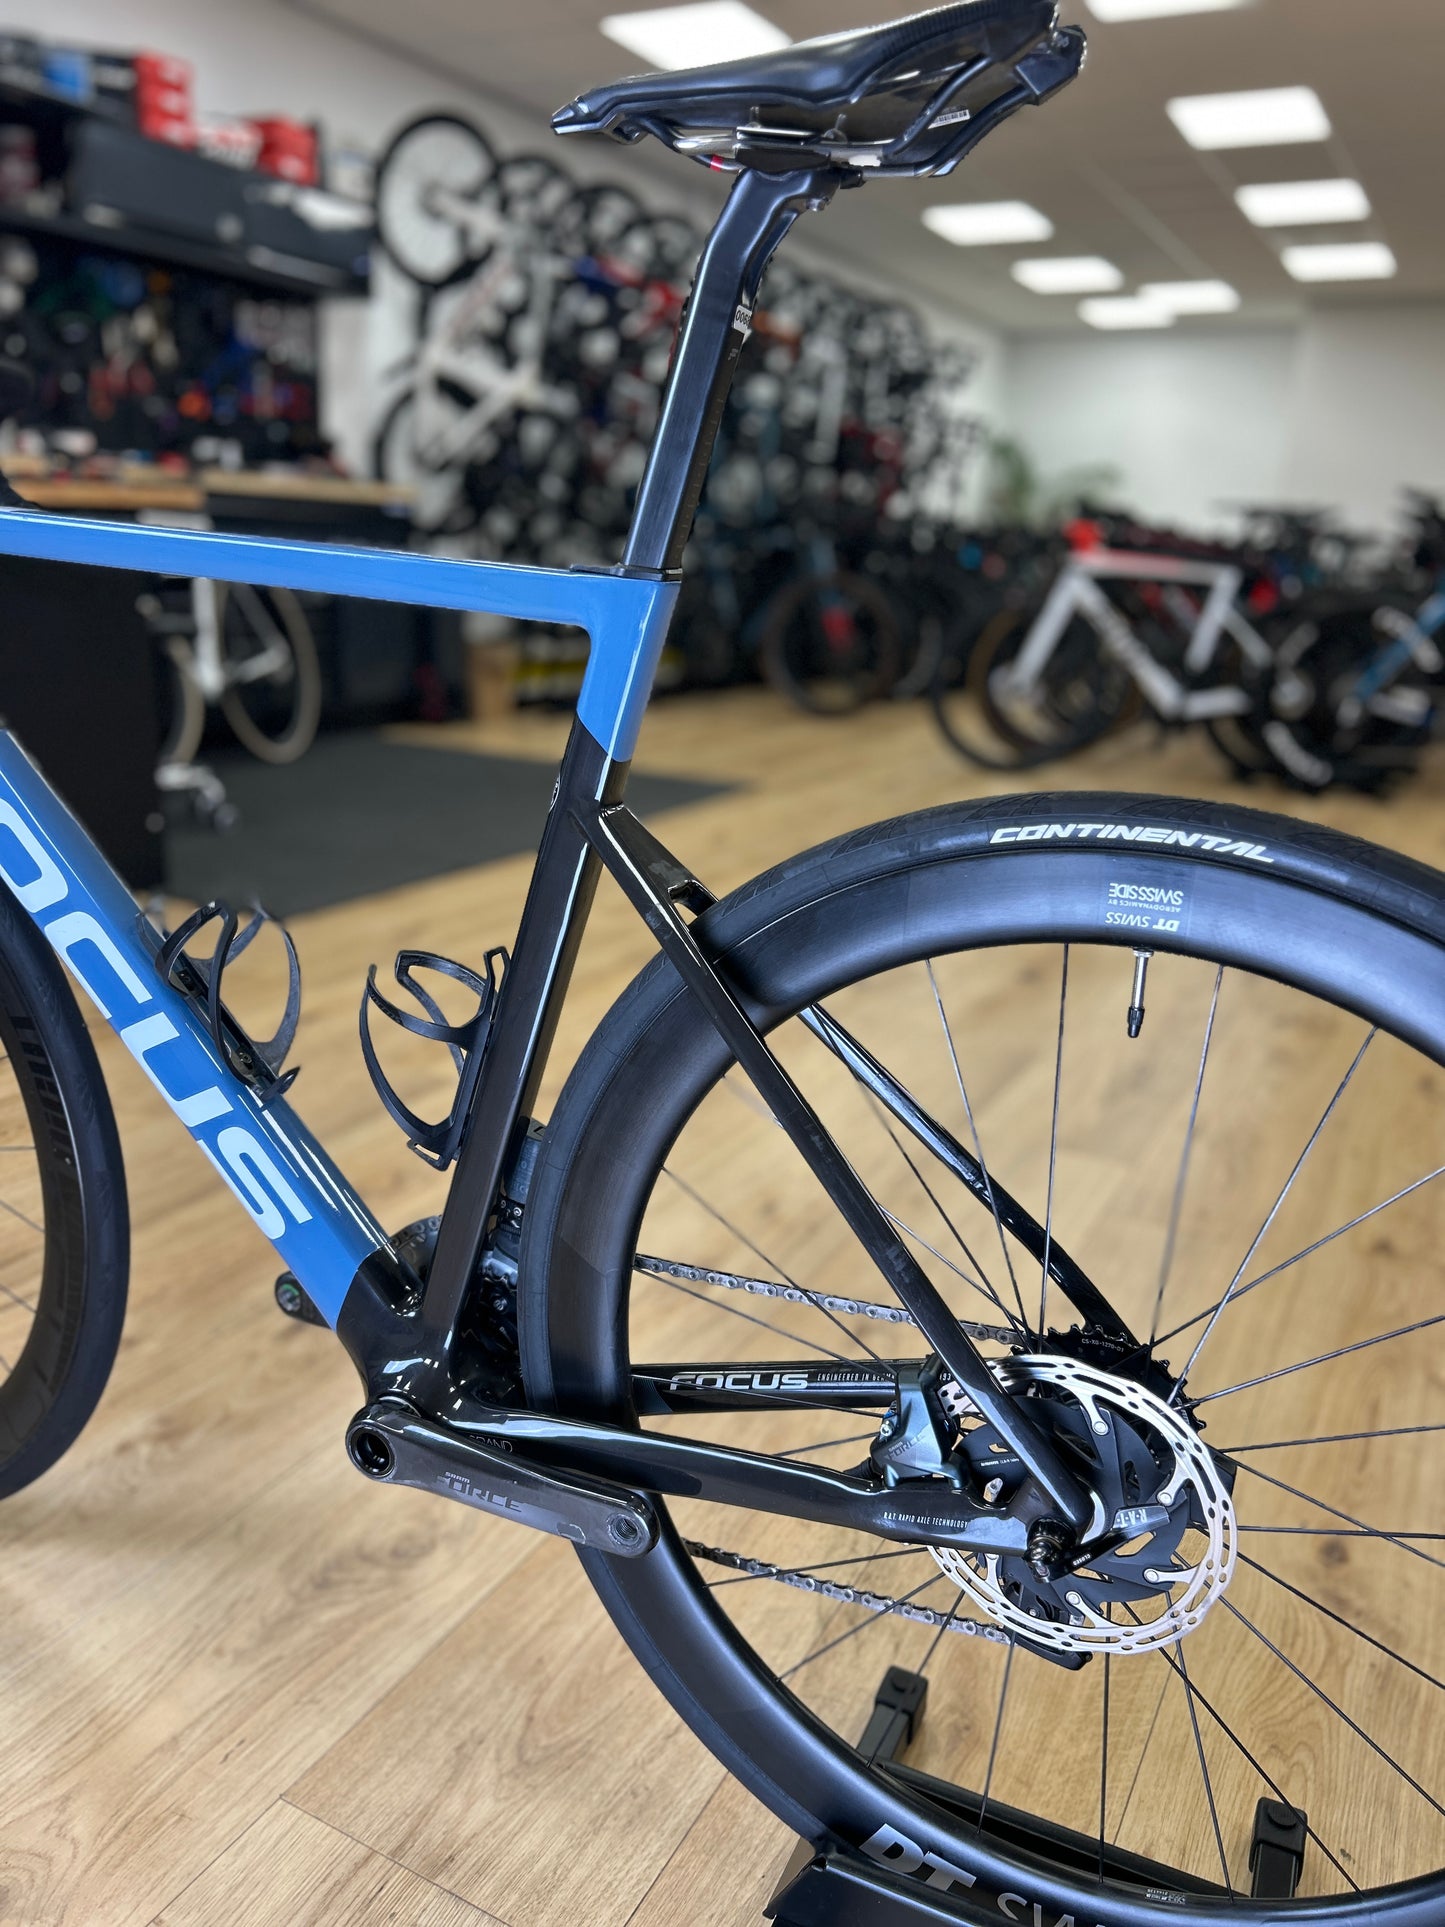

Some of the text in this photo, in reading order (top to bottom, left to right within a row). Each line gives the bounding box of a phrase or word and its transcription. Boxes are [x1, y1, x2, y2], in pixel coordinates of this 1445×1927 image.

[989, 823, 1274, 863] CONTINENTAL
[1119, 901, 1181, 912] AERODYNAMICS
[1105, 912, 1180, 932] DT SWISS
[670, 1373, 808, 1390] FOCUS
[817, 1373, 859, 1381] ENGINEERED
[862, 1373, 869, 1381] IN
[898, 1513, 916, 1523] RAPID
[916, 1516, 931, 1525] AXLE
[932, 1517, 968, 1528] TECHNOLOGY
[859, 1823, 977, 1892] DT
